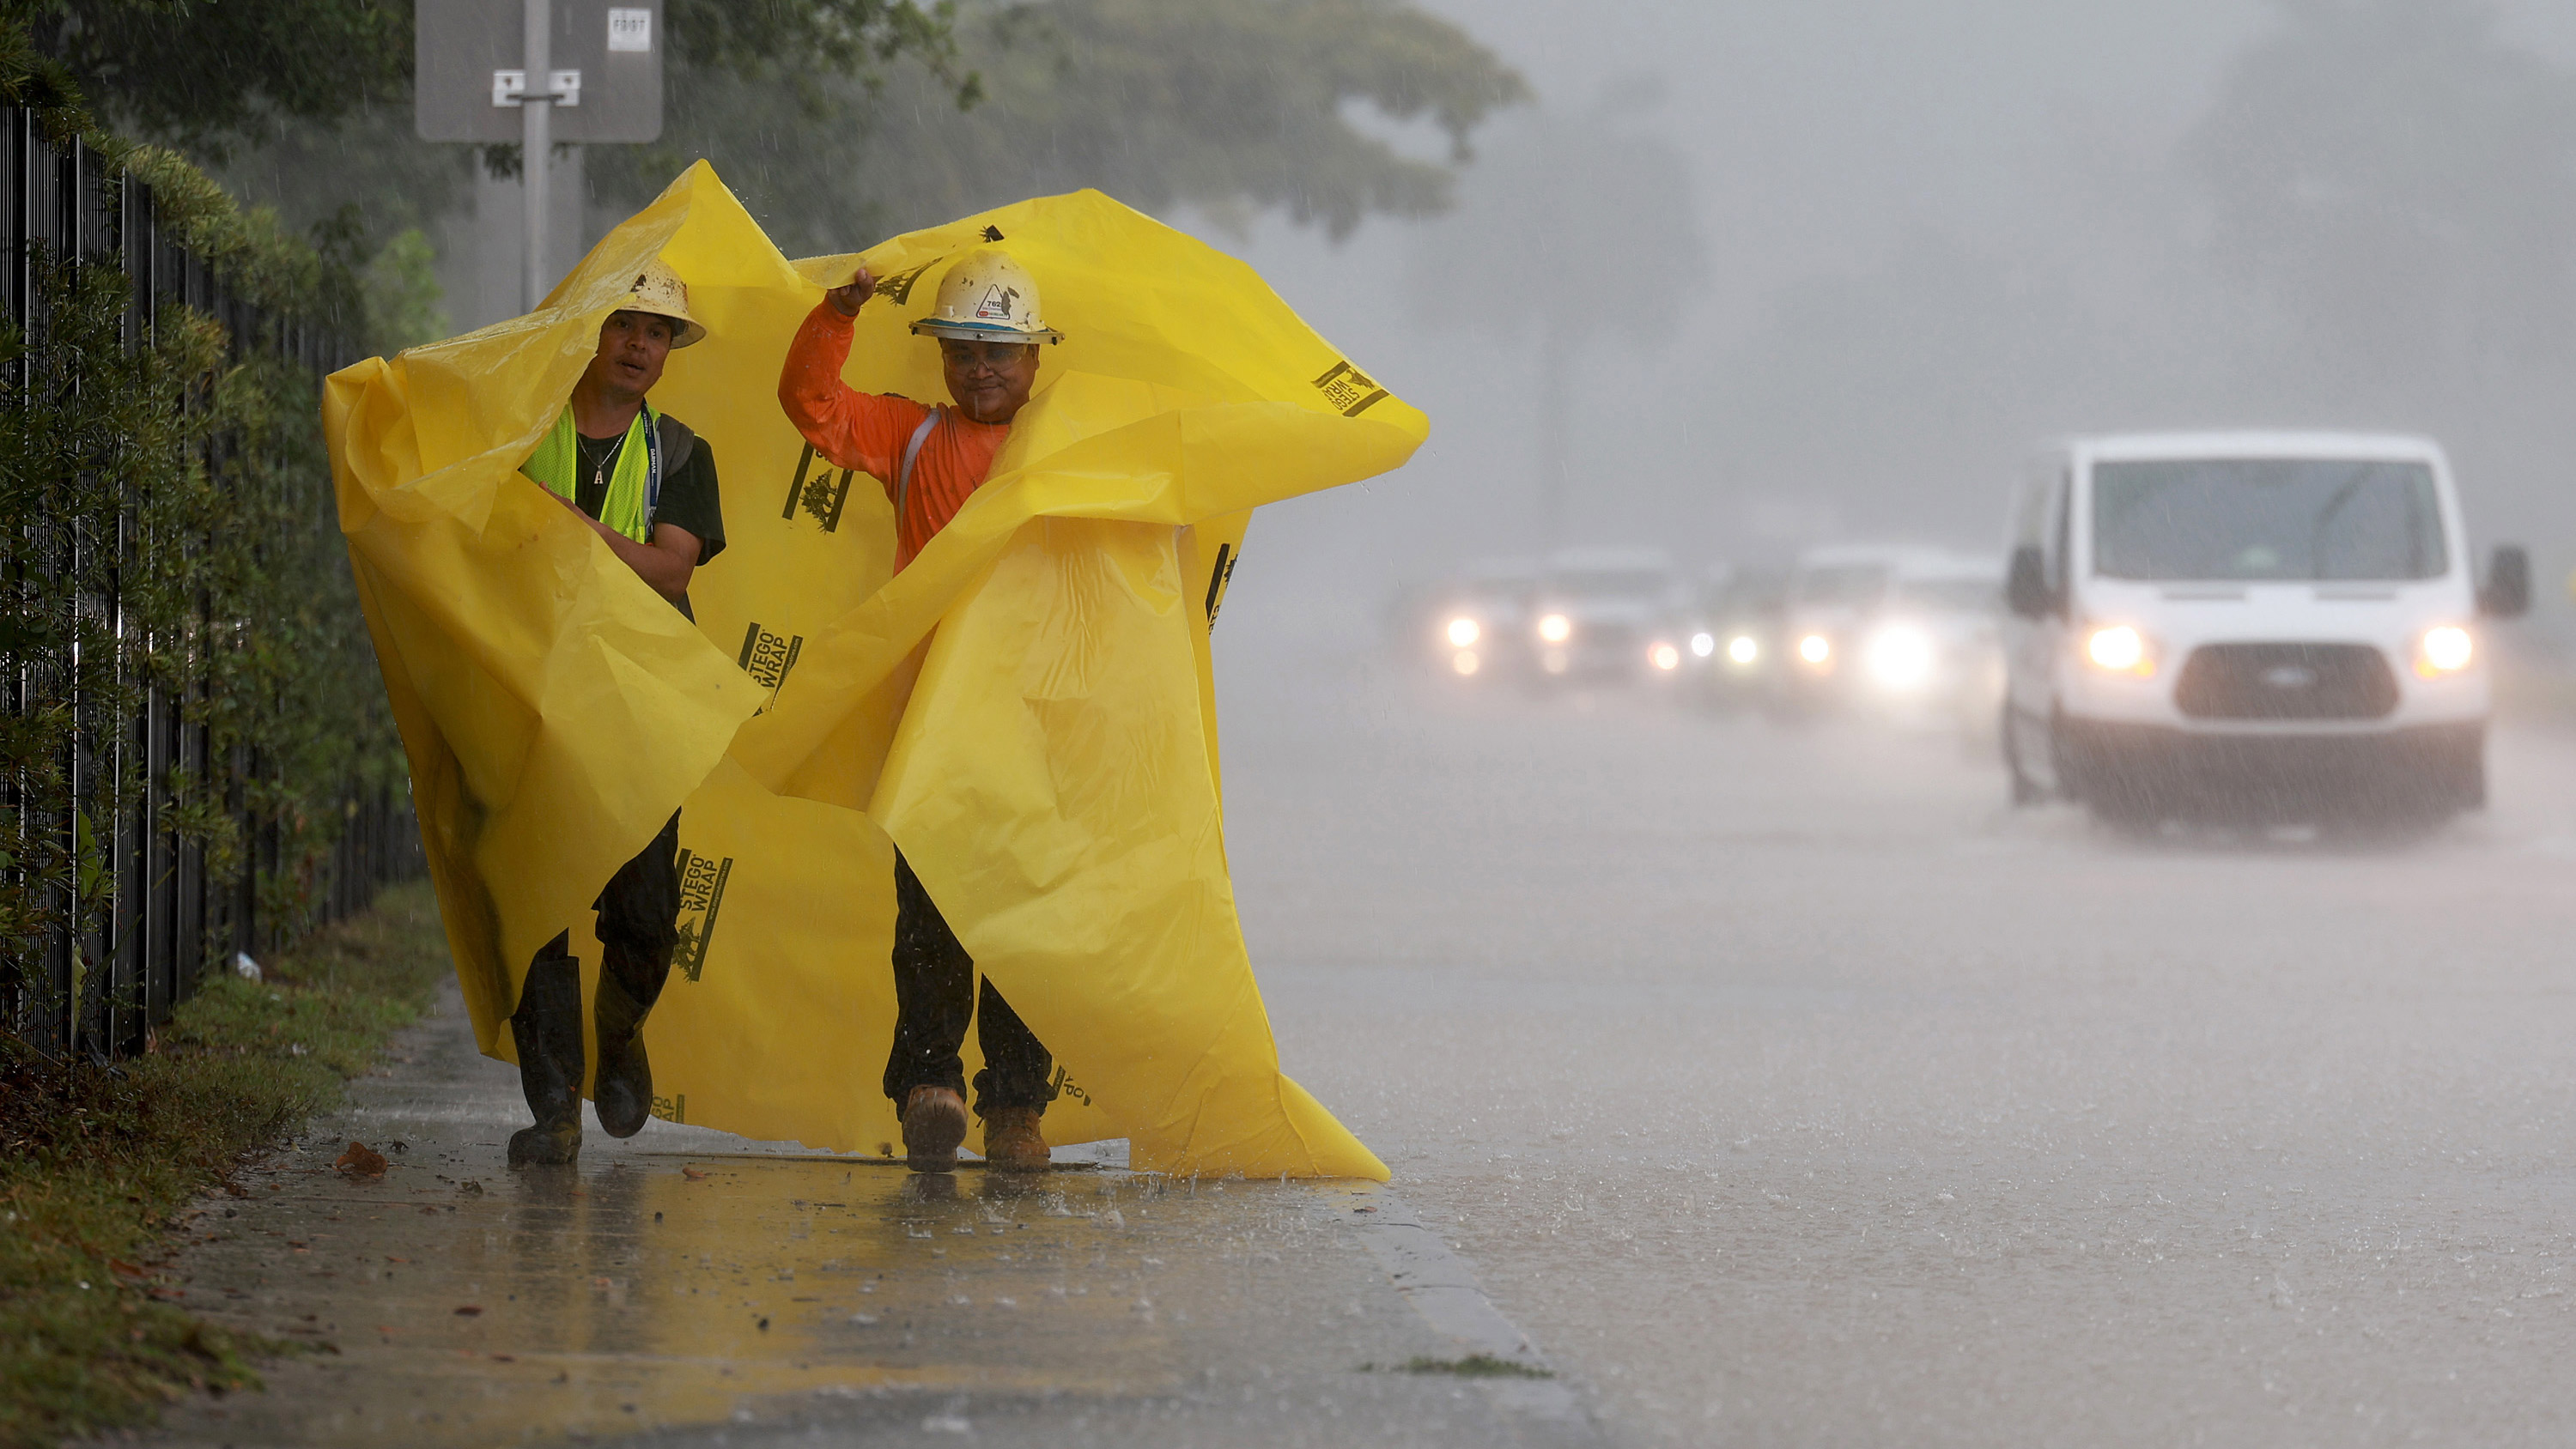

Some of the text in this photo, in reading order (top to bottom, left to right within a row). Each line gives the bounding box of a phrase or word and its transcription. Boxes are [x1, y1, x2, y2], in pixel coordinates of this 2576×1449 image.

[1332, 388, 1360, 410] STEGO
[594, 471, 604, 484] A
[762, 637, 787, 688] WRAP
[680, 857, 704, 910] STEGO
[692, 860, 717, 912] WRAP
